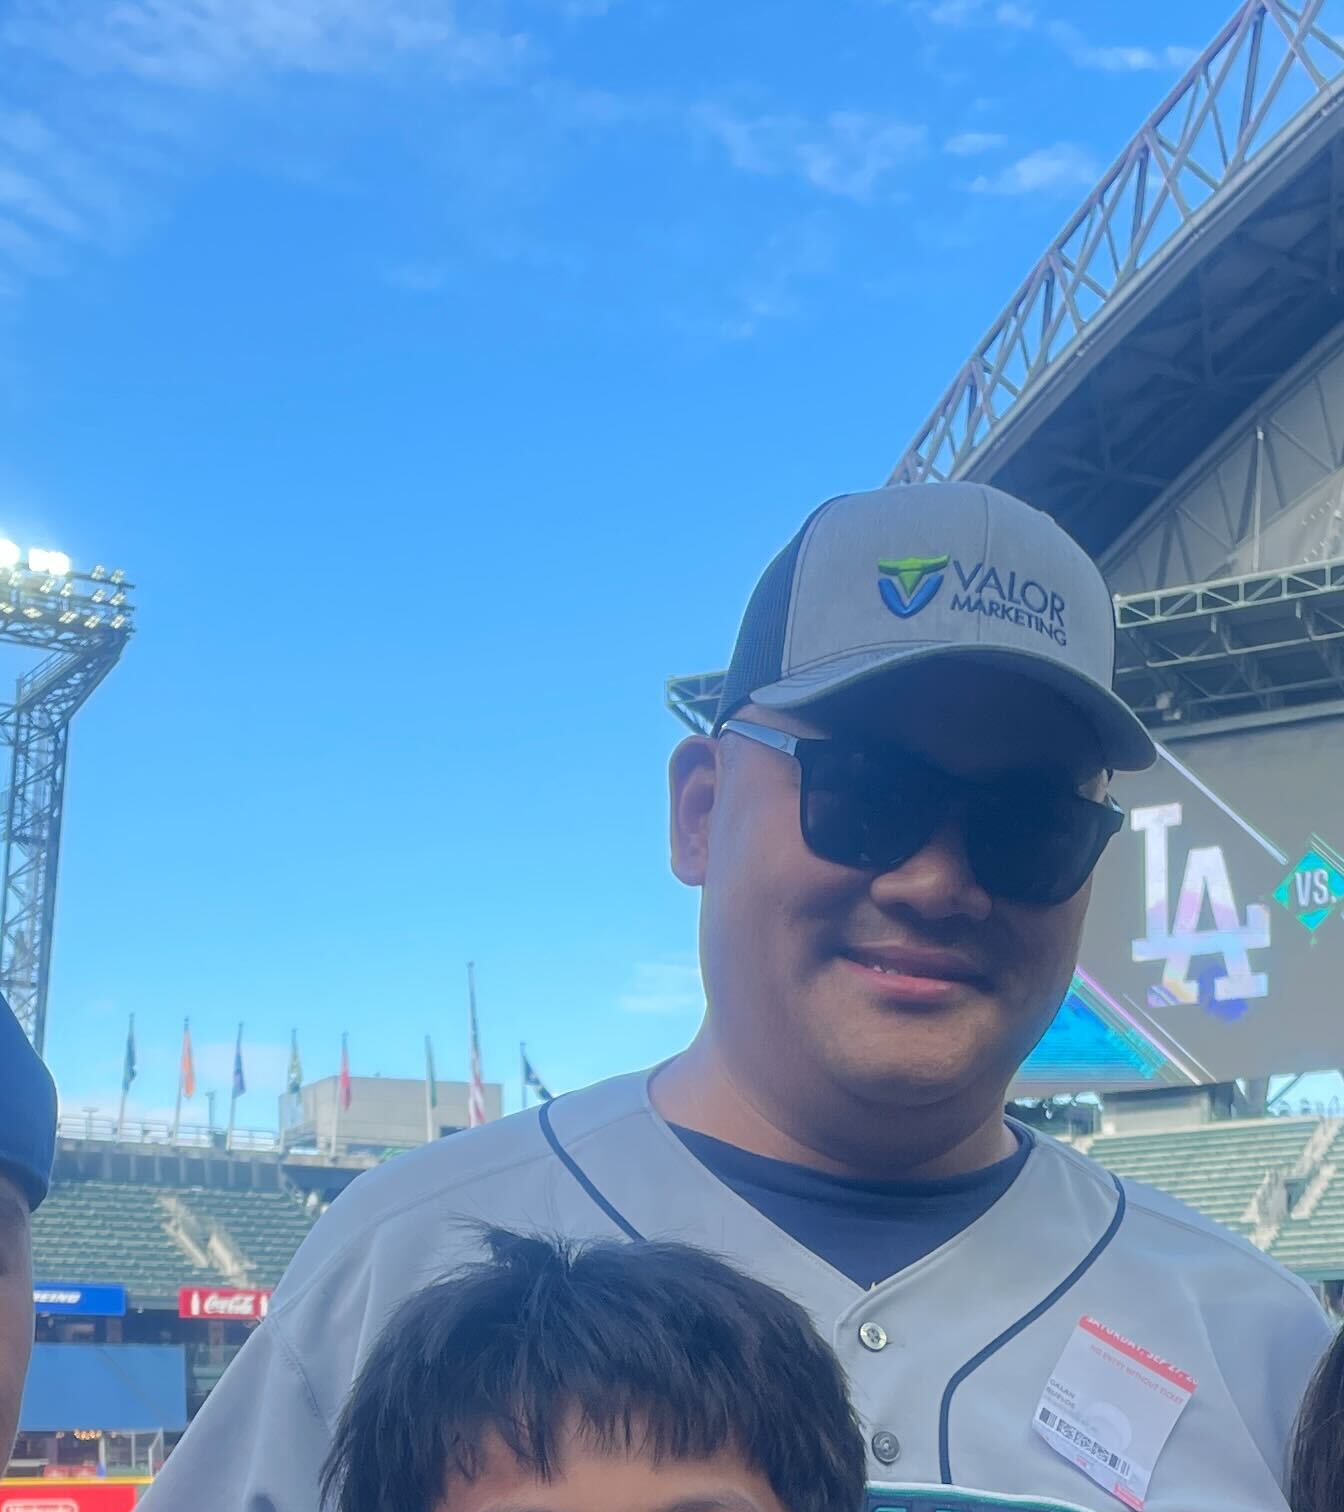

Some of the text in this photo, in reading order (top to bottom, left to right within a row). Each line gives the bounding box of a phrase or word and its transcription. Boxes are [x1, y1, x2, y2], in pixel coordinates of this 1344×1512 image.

[951, 593, 1067, 647] MARKETING
[953, 560, 1065, 628] VALOR
[1131, 802, 1271, 1008] LA
[1295, 869, 1337, 907] VS.
